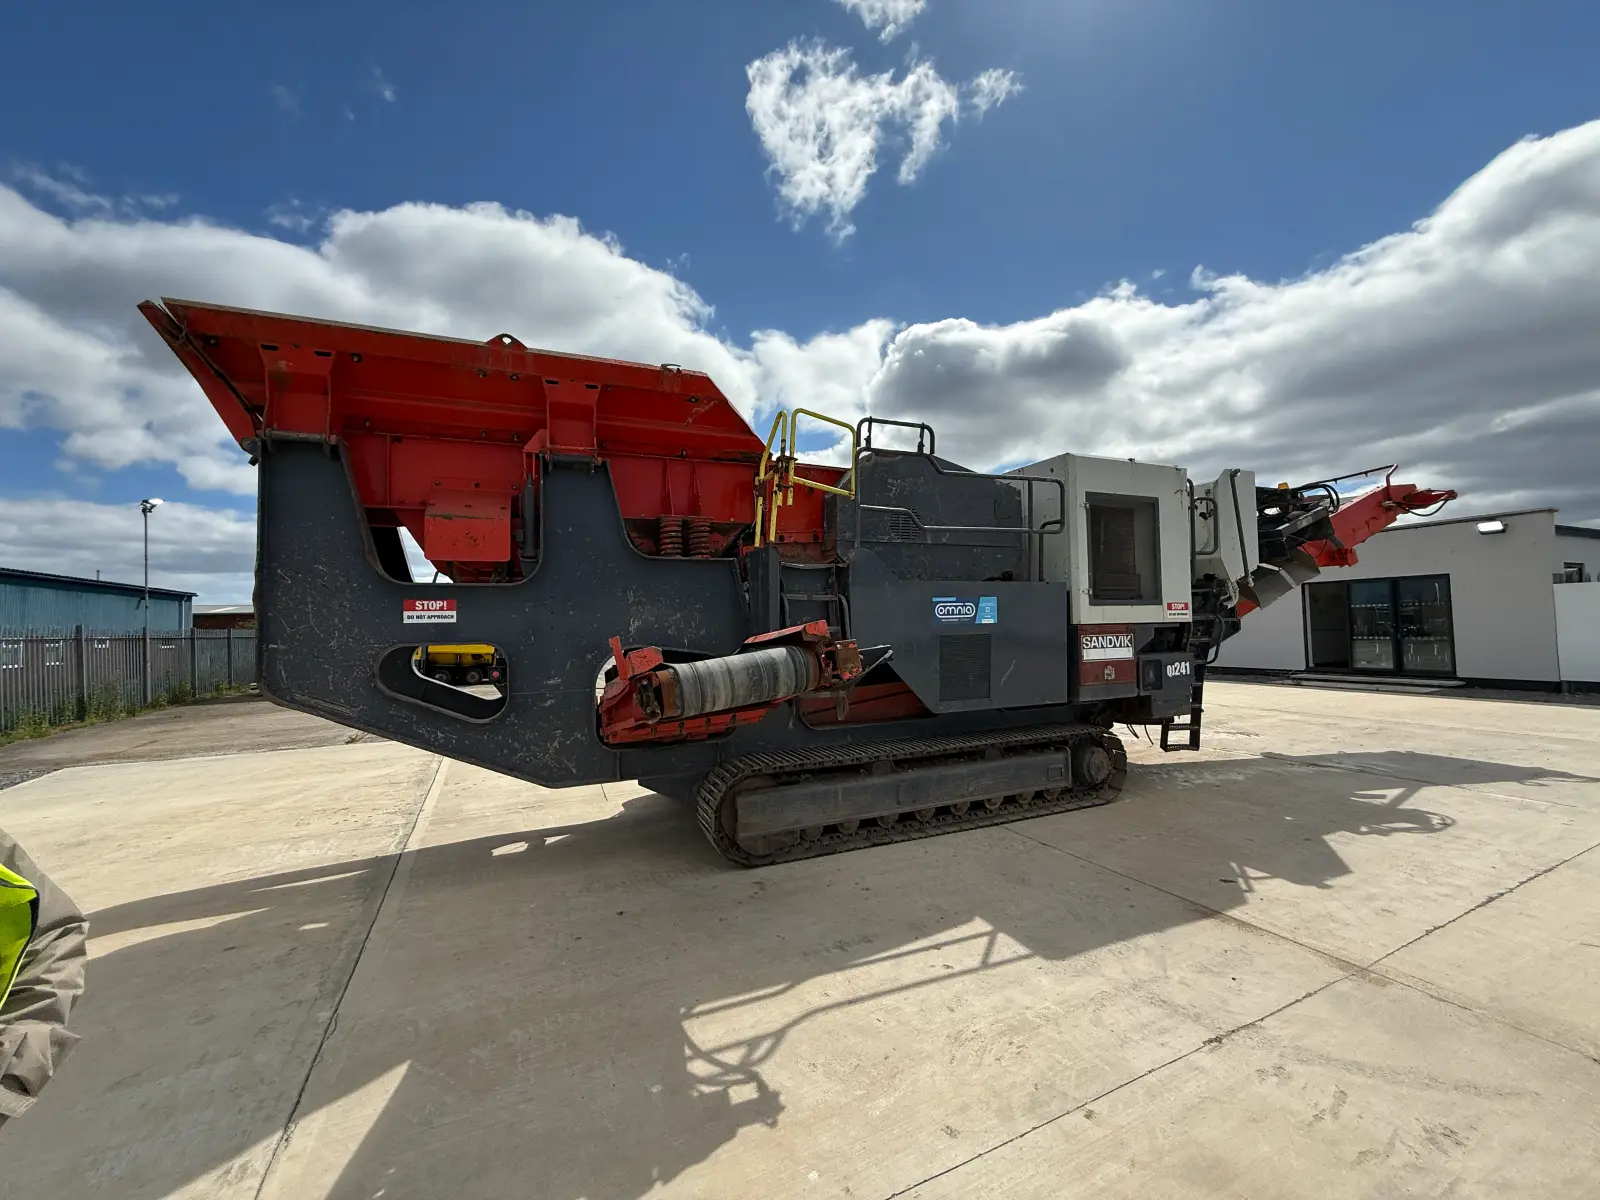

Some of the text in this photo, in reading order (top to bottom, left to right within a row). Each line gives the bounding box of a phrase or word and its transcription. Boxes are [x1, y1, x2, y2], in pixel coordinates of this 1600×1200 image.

[415, 600, 447, 610] STOP!
[937, 605, 973, 615] omnia
[1083, 635, 1131, 648] SANDVIK
[1166, 661, 1191, 677] QJ241
